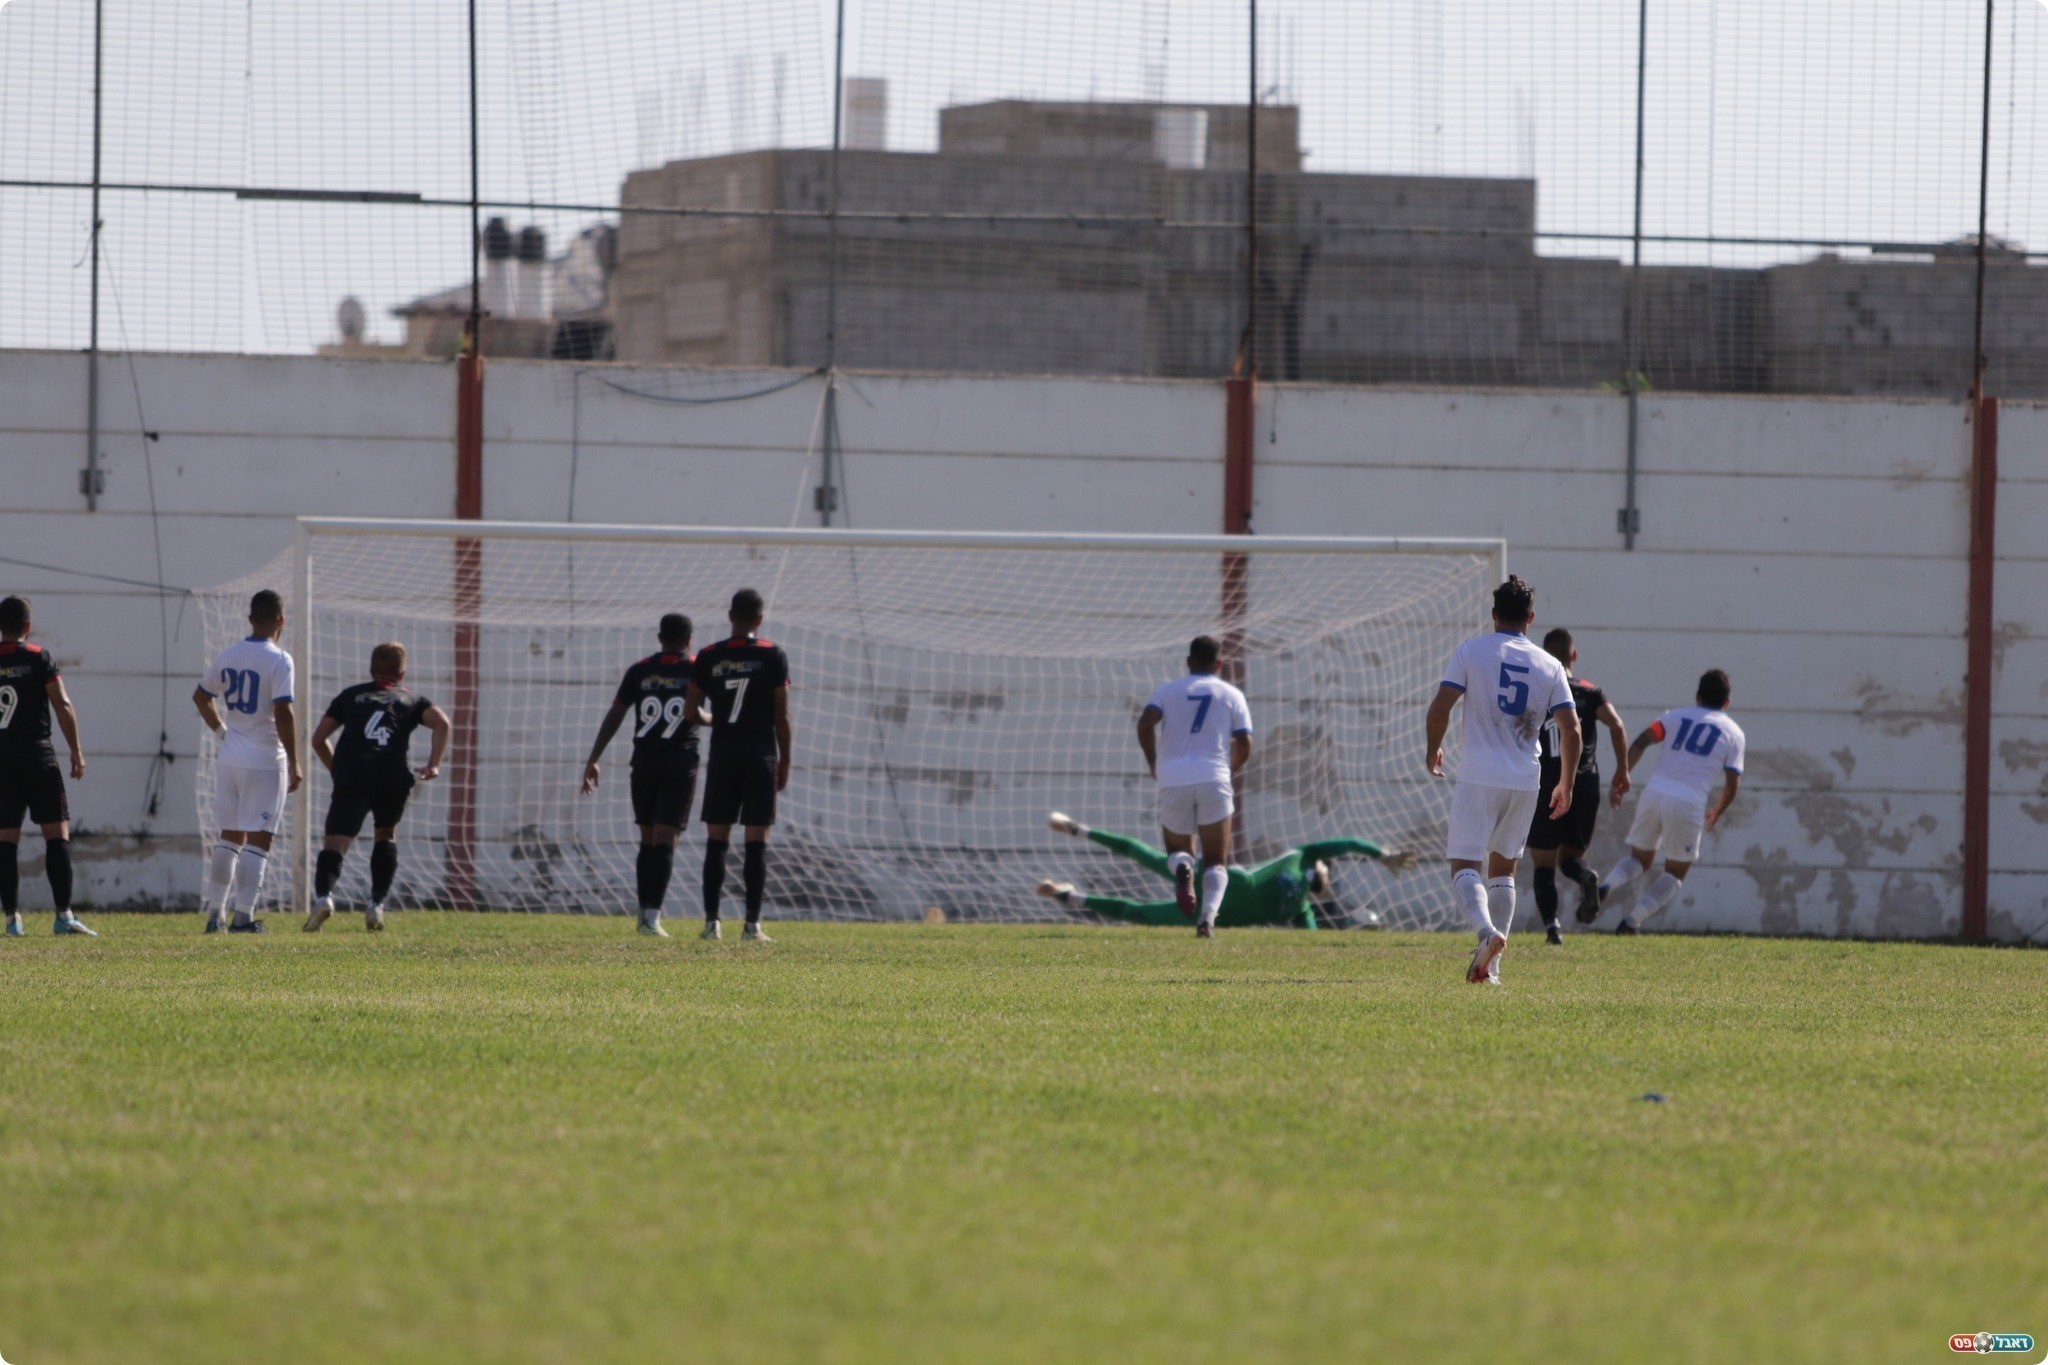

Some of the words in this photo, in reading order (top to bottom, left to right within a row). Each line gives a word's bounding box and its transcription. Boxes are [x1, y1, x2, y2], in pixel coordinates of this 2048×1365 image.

[221, 667, 260, 715] 20
[725, 678, 749, 723] 7
[1497, 662, 1529, 716] 5
[364, 710, 391, 746] 4
[636, 696, 685, 739] 99
[1187, 694, 1212, 734] 7
[1671, 717, 1722, 757] 10
